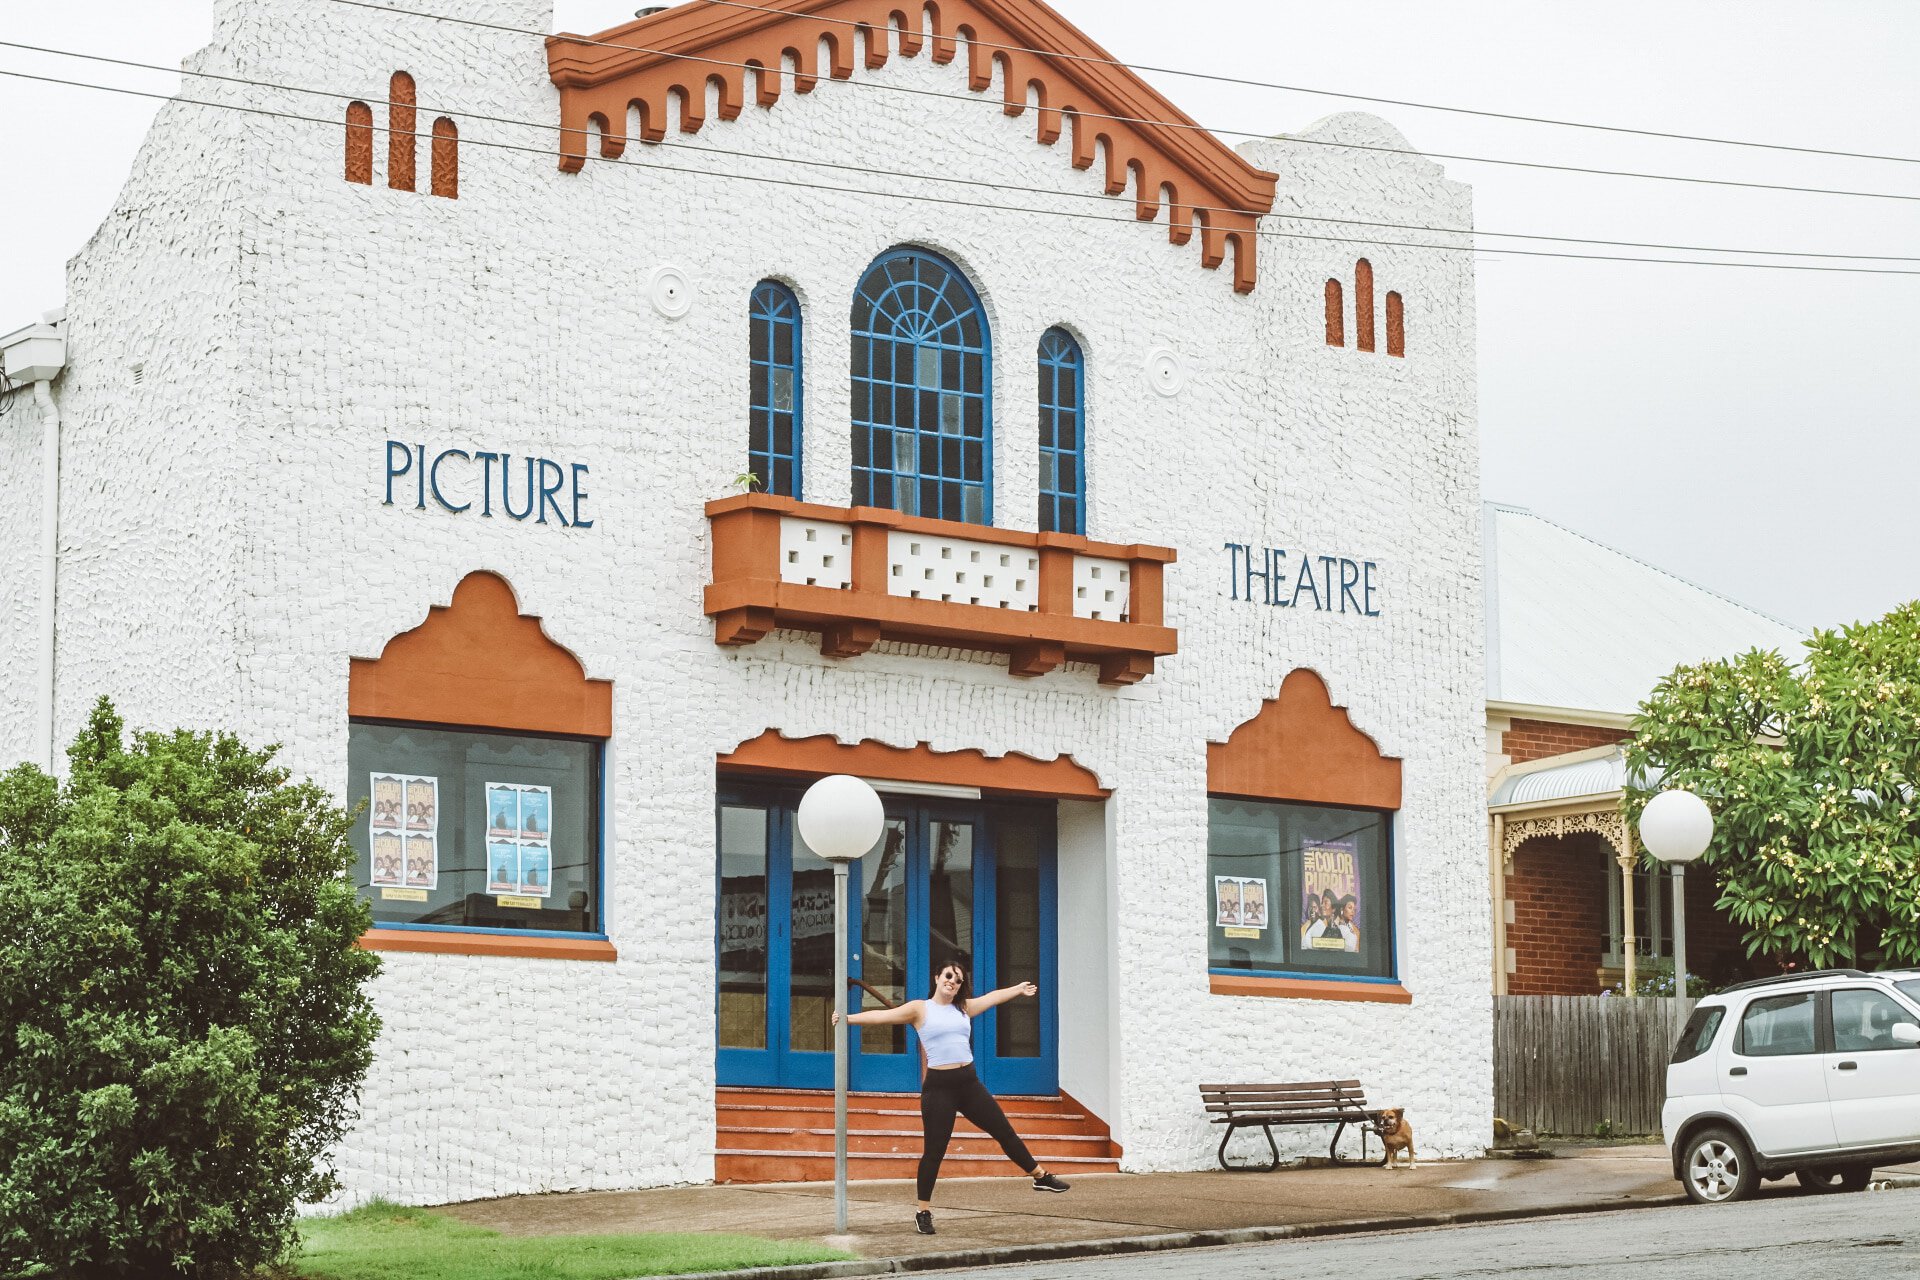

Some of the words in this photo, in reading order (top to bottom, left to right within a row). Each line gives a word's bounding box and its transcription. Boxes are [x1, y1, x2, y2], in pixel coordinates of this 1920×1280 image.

[382, 440, 594, 528] PICTURE
[1224, 543, 1380, 617] THEATRE
[1304, 851, 1315, 872] THE
[1315, 851, 1353, 875] COLOR
[1305, 871, 1355, 896] PURPLE
